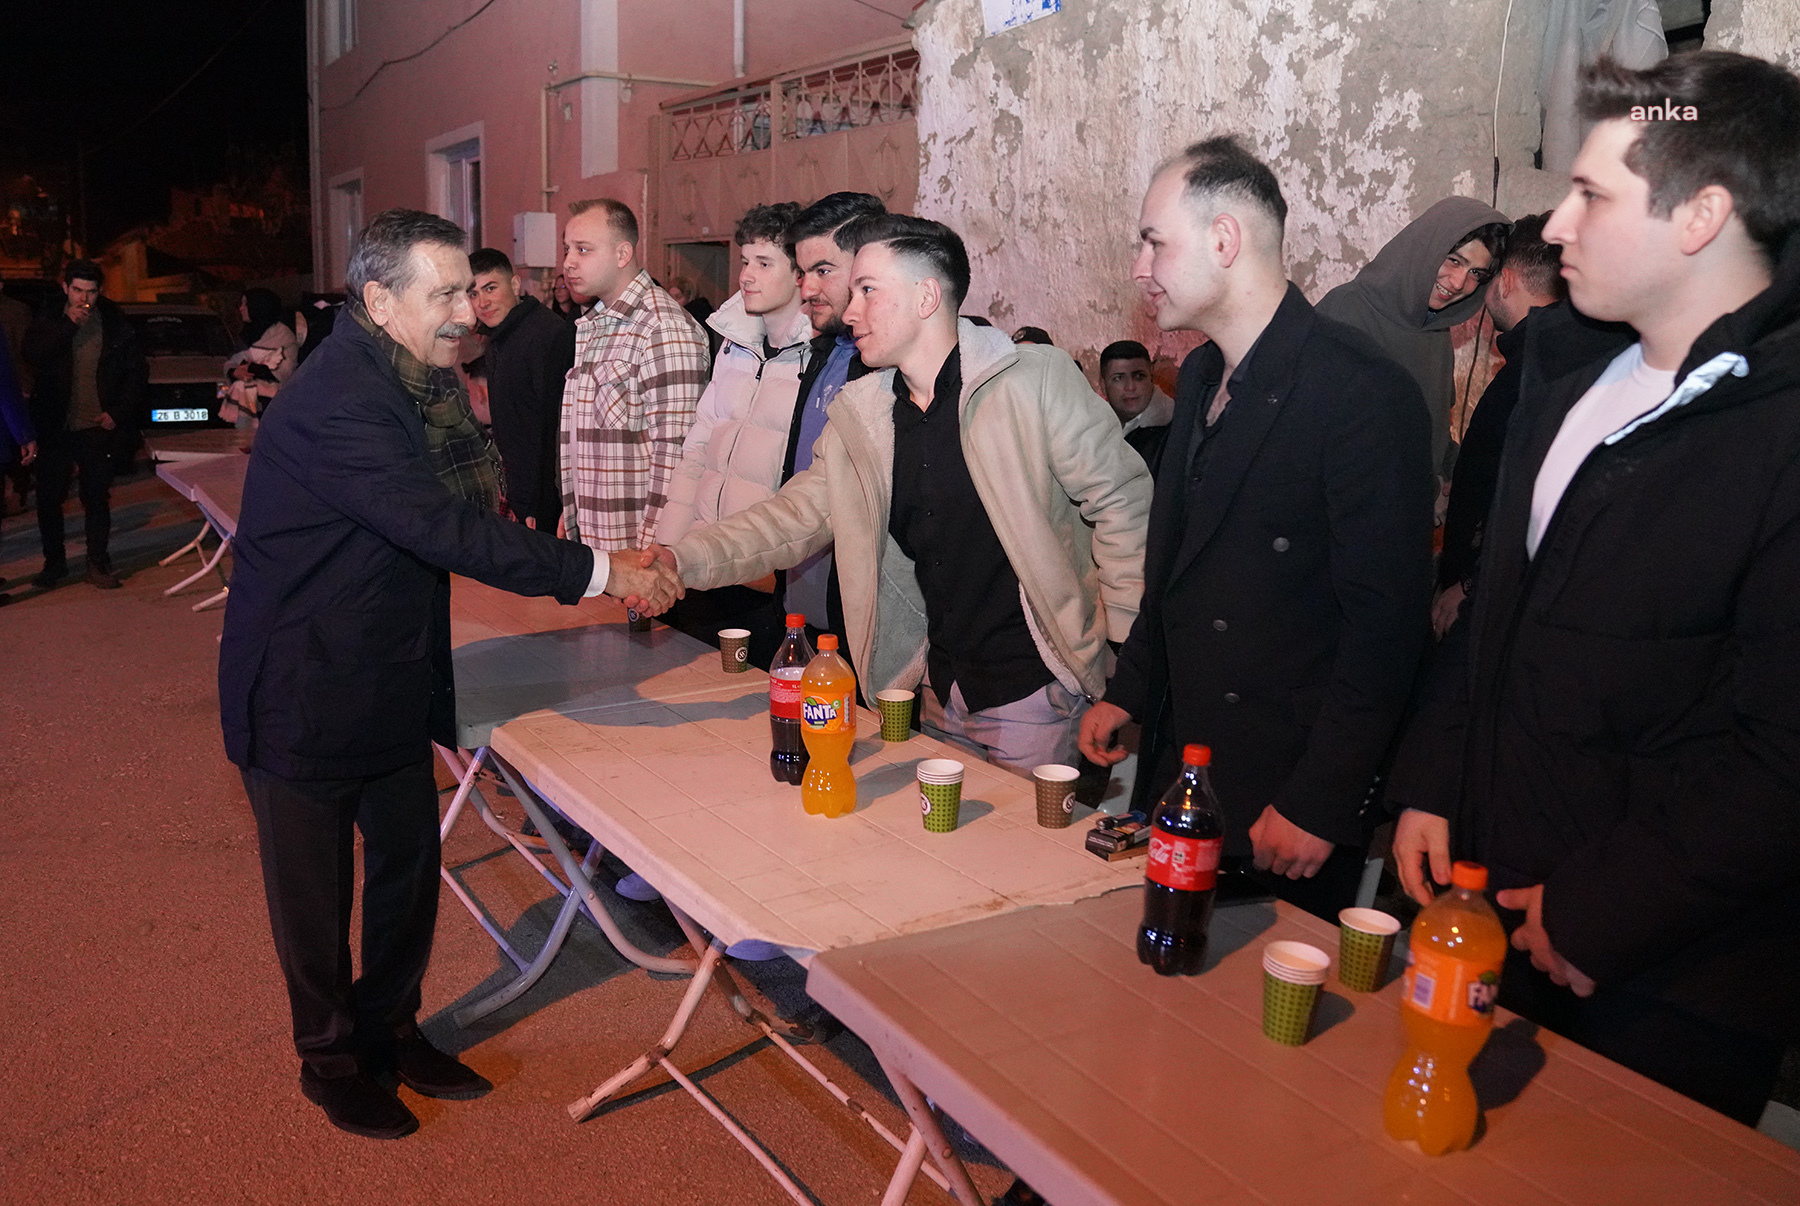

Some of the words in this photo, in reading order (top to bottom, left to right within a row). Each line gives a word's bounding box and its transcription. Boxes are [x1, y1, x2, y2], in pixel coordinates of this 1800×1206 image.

[158, 411, 169, 420] 26
[174, 411, 180, 420] B
[803, 702, 837, 720] FANTA
